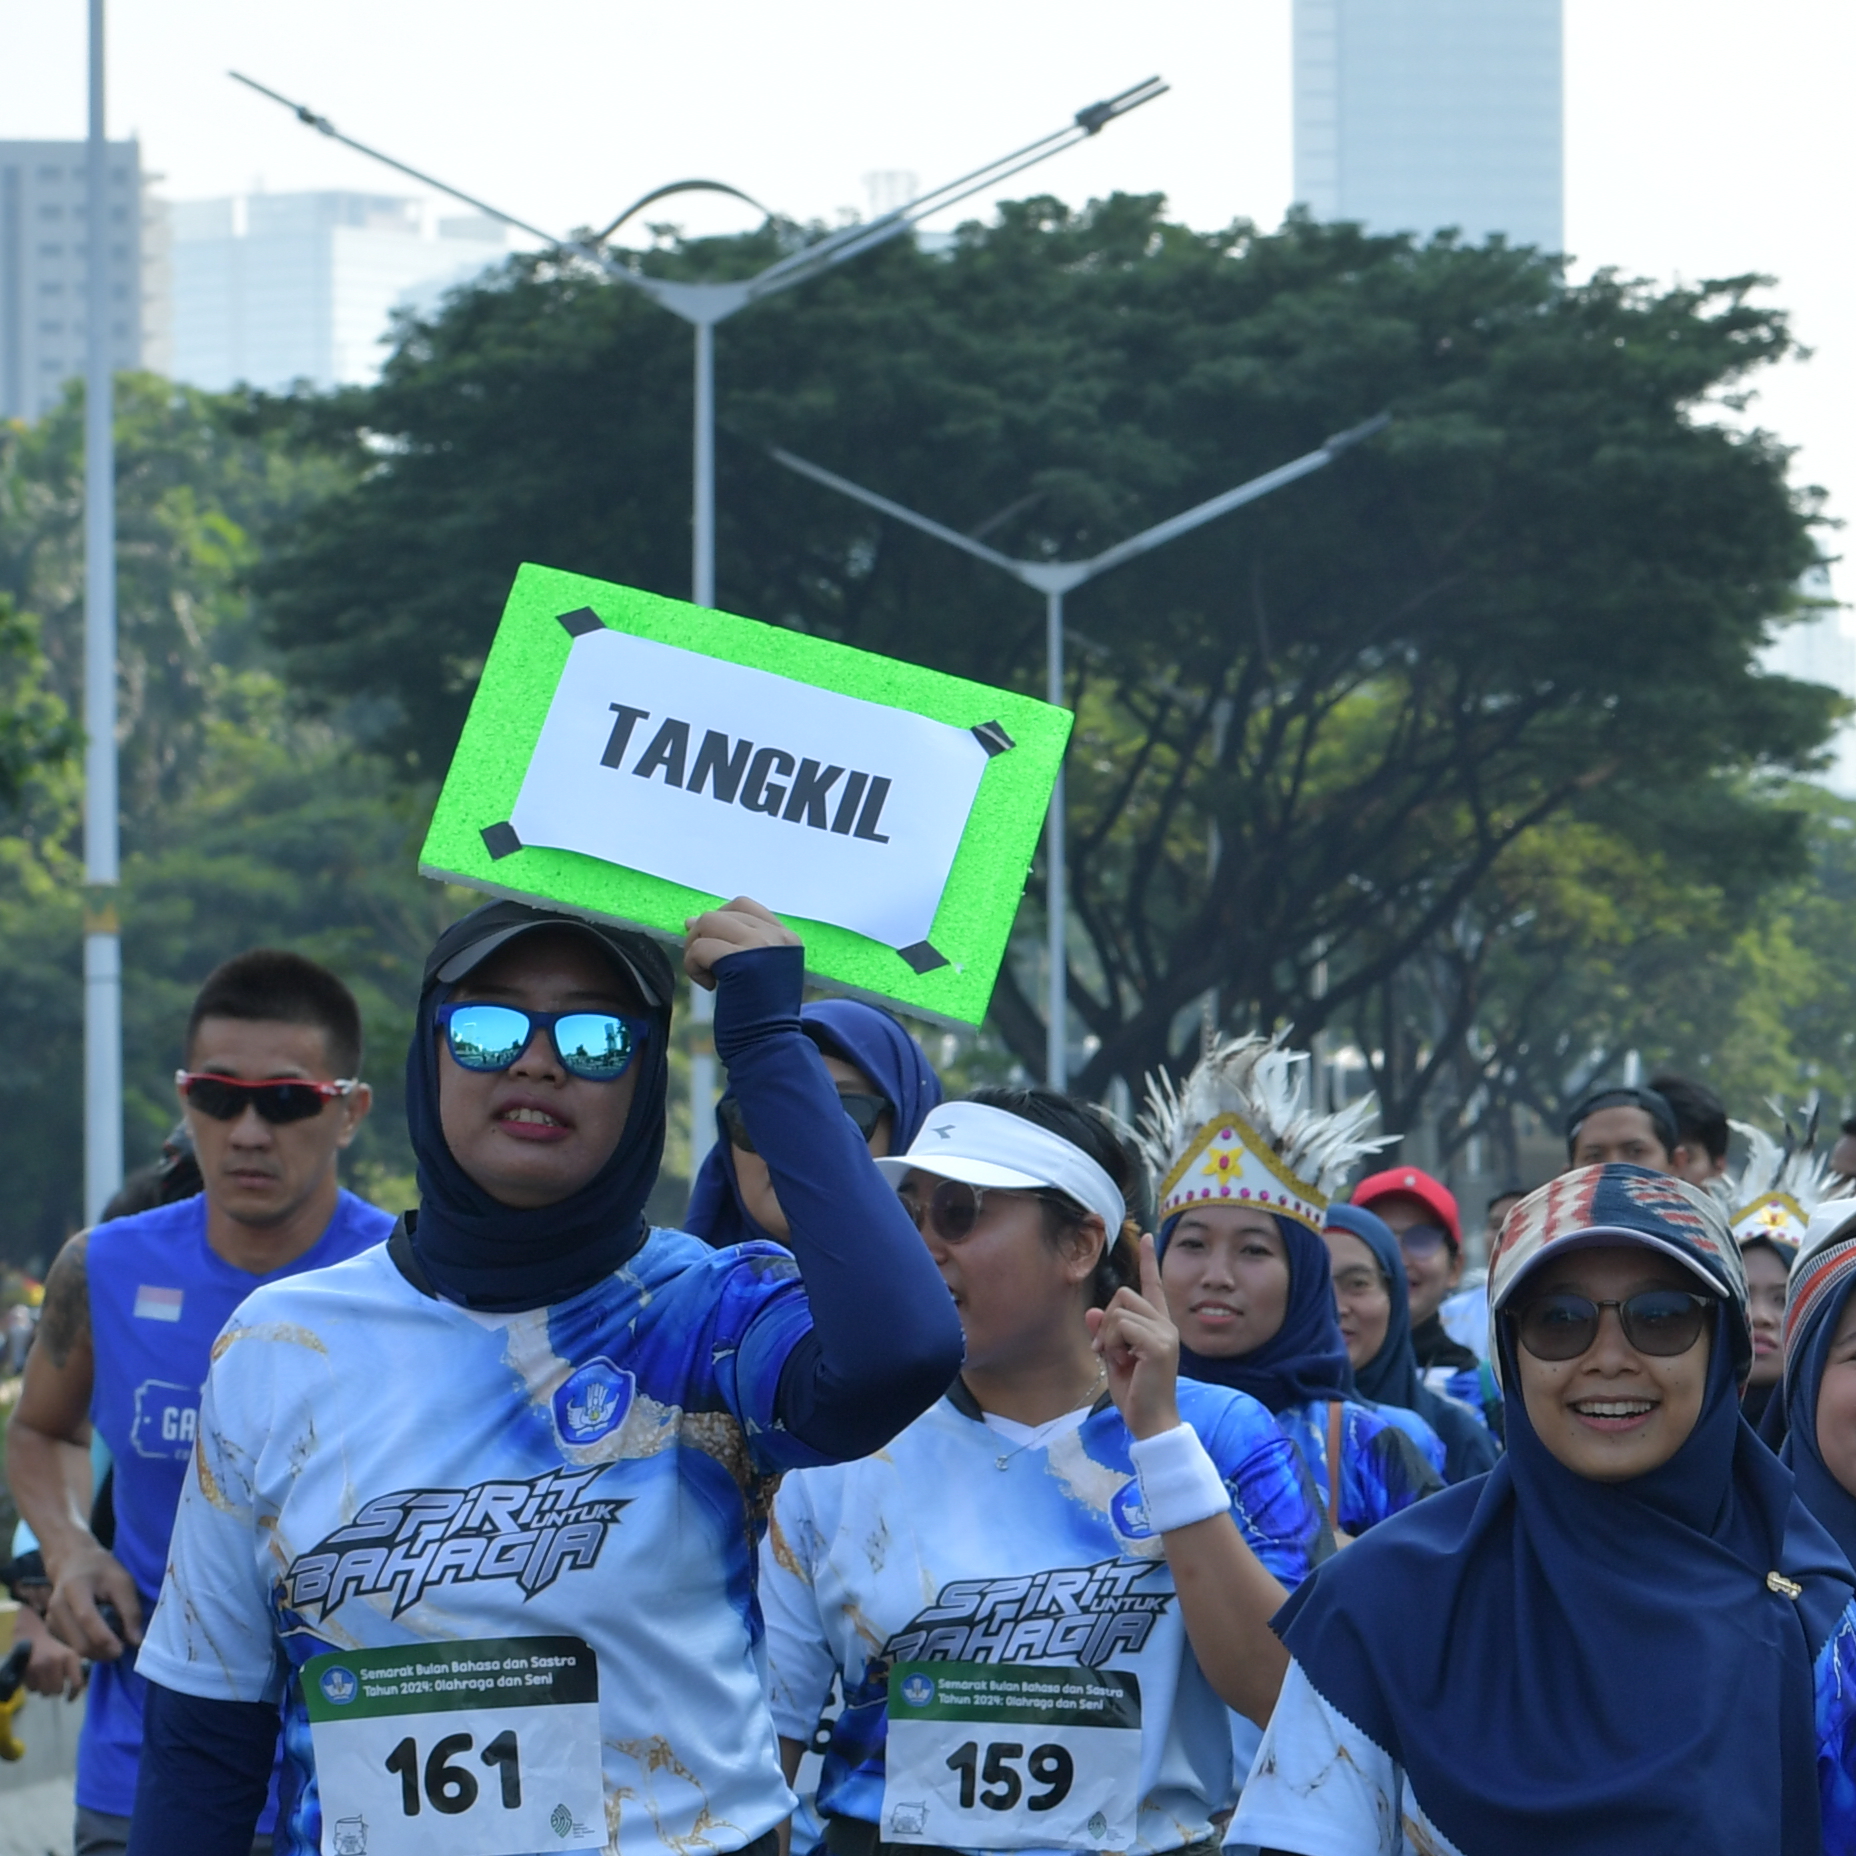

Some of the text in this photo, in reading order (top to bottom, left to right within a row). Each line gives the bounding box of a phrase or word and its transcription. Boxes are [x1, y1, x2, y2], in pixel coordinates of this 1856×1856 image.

[600, 702, 892, 844] TANGKIL
[532, 1503, 616, 1530] UNTUK
[291, 1522, 607, 1612] BAHAGIA
[1090, 1596, 1169, 1613] UNTUK
[360, 1655, 576, 1681] Semarak Bulan Bahasa dan Sastra
[363, 1671, 553, 1698] Tahun 2024: Olahraga dan Seni
[937, 1678, 988, 1692] Semarak
[989, 1680, 1020, 1692] Bulan
[1022, 1681, 1060, 1694] Bahasa
[1062, 1682, 1084, 1695] dan
[938, 1693, 971, 1706] Tahun
[1056, 1696, 1077, 1709] dan
[1079, 1697, 1104, 1711] Seni
[385, 1730, 522, 1816] 161
[946, 1741, 1074, 1812] 159
